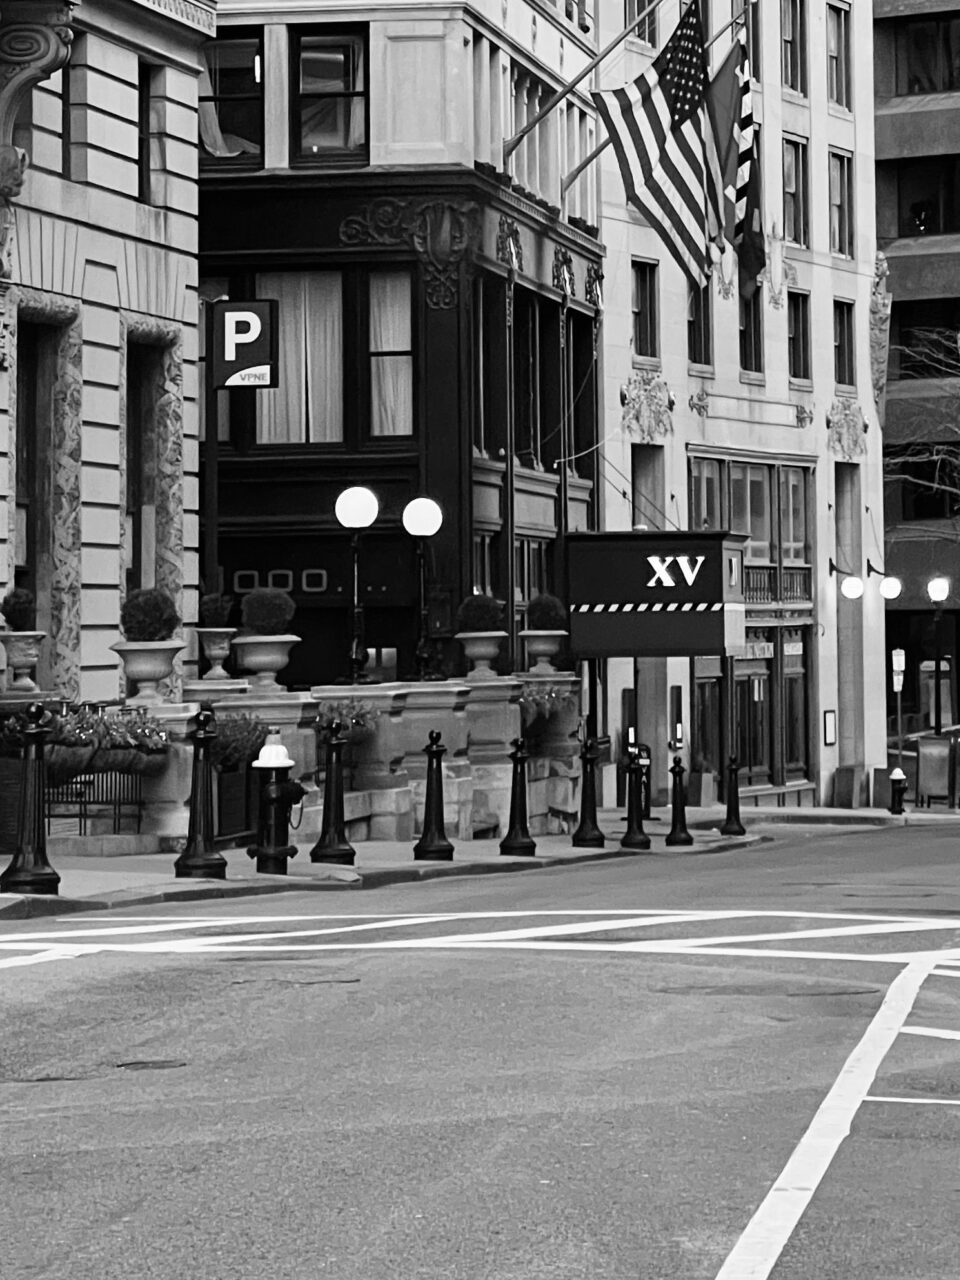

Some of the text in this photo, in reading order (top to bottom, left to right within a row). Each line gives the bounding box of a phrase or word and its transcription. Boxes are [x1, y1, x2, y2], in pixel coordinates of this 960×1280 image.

[225, 308, 262, 361] P
[240, 372, 268, 382] VPNE
[646, 556, 705, 587] XV
